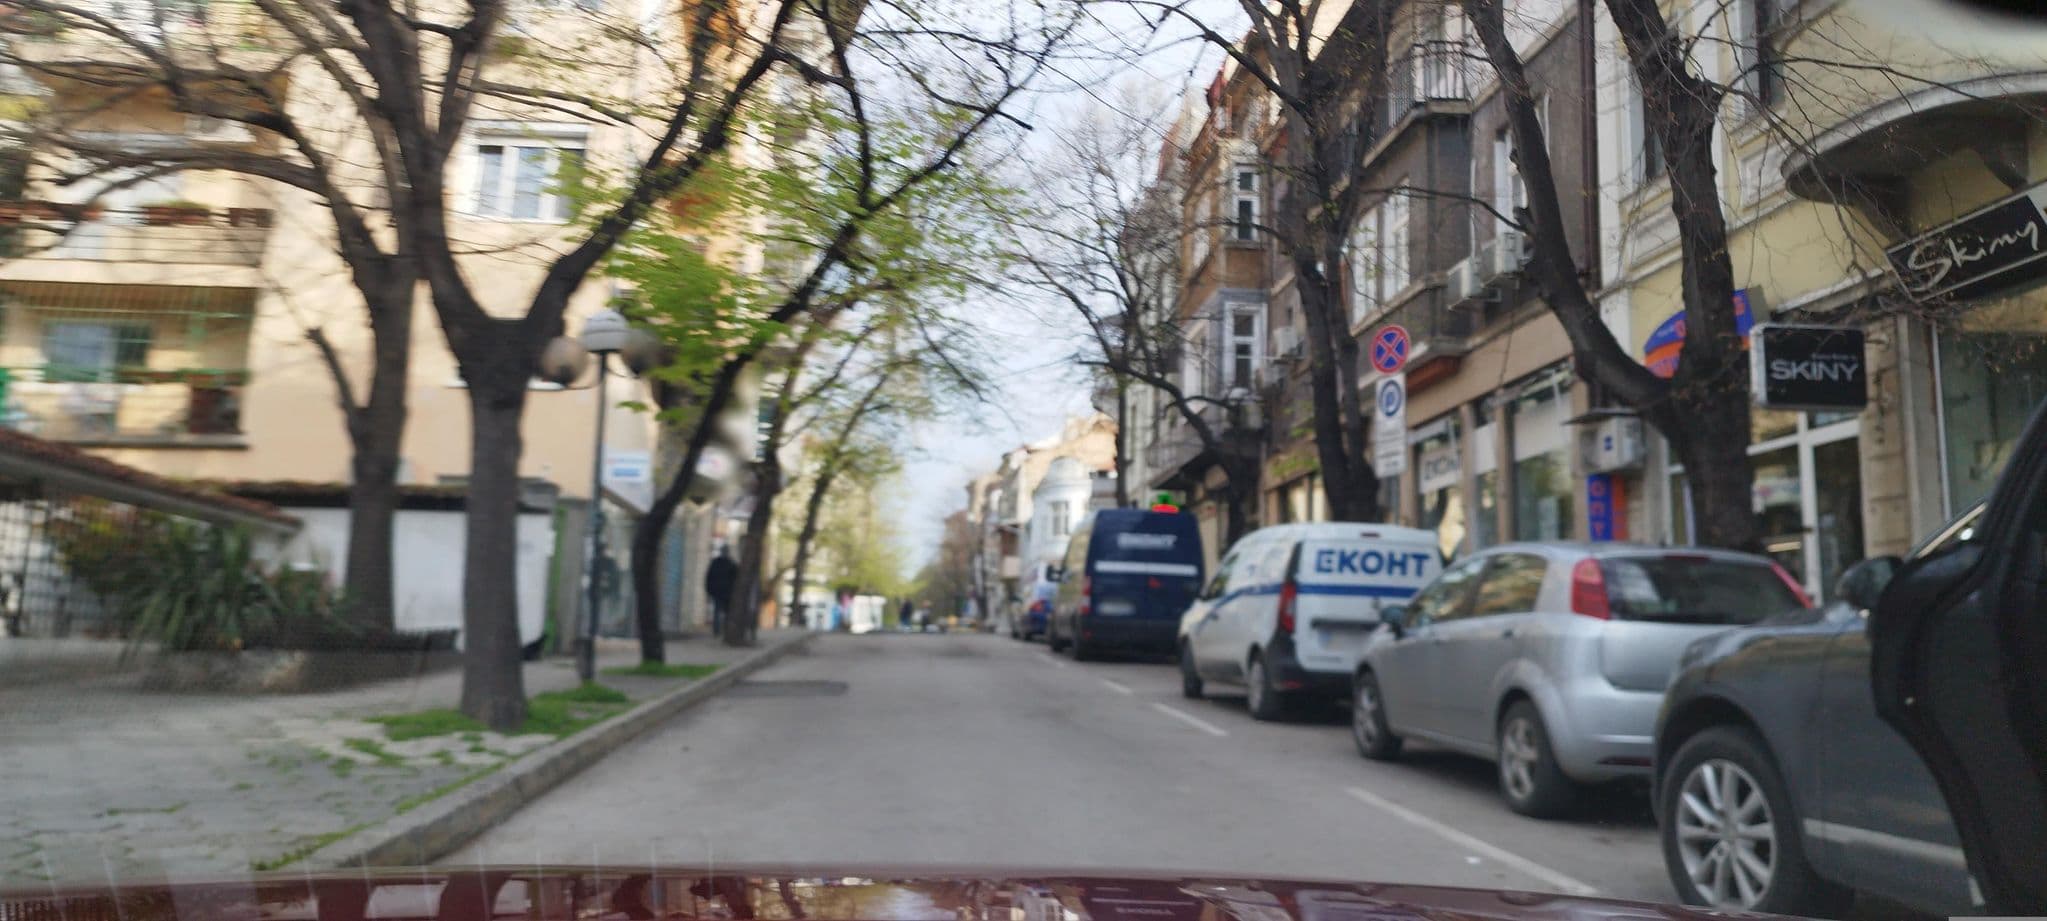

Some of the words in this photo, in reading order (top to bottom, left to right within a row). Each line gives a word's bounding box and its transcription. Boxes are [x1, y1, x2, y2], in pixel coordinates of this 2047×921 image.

[1907, 220, 2039, 293] Skiny
[1770, 359, 1859, 381] SKINY
[1315, 550, 1432, 576] ЕКОНТ
